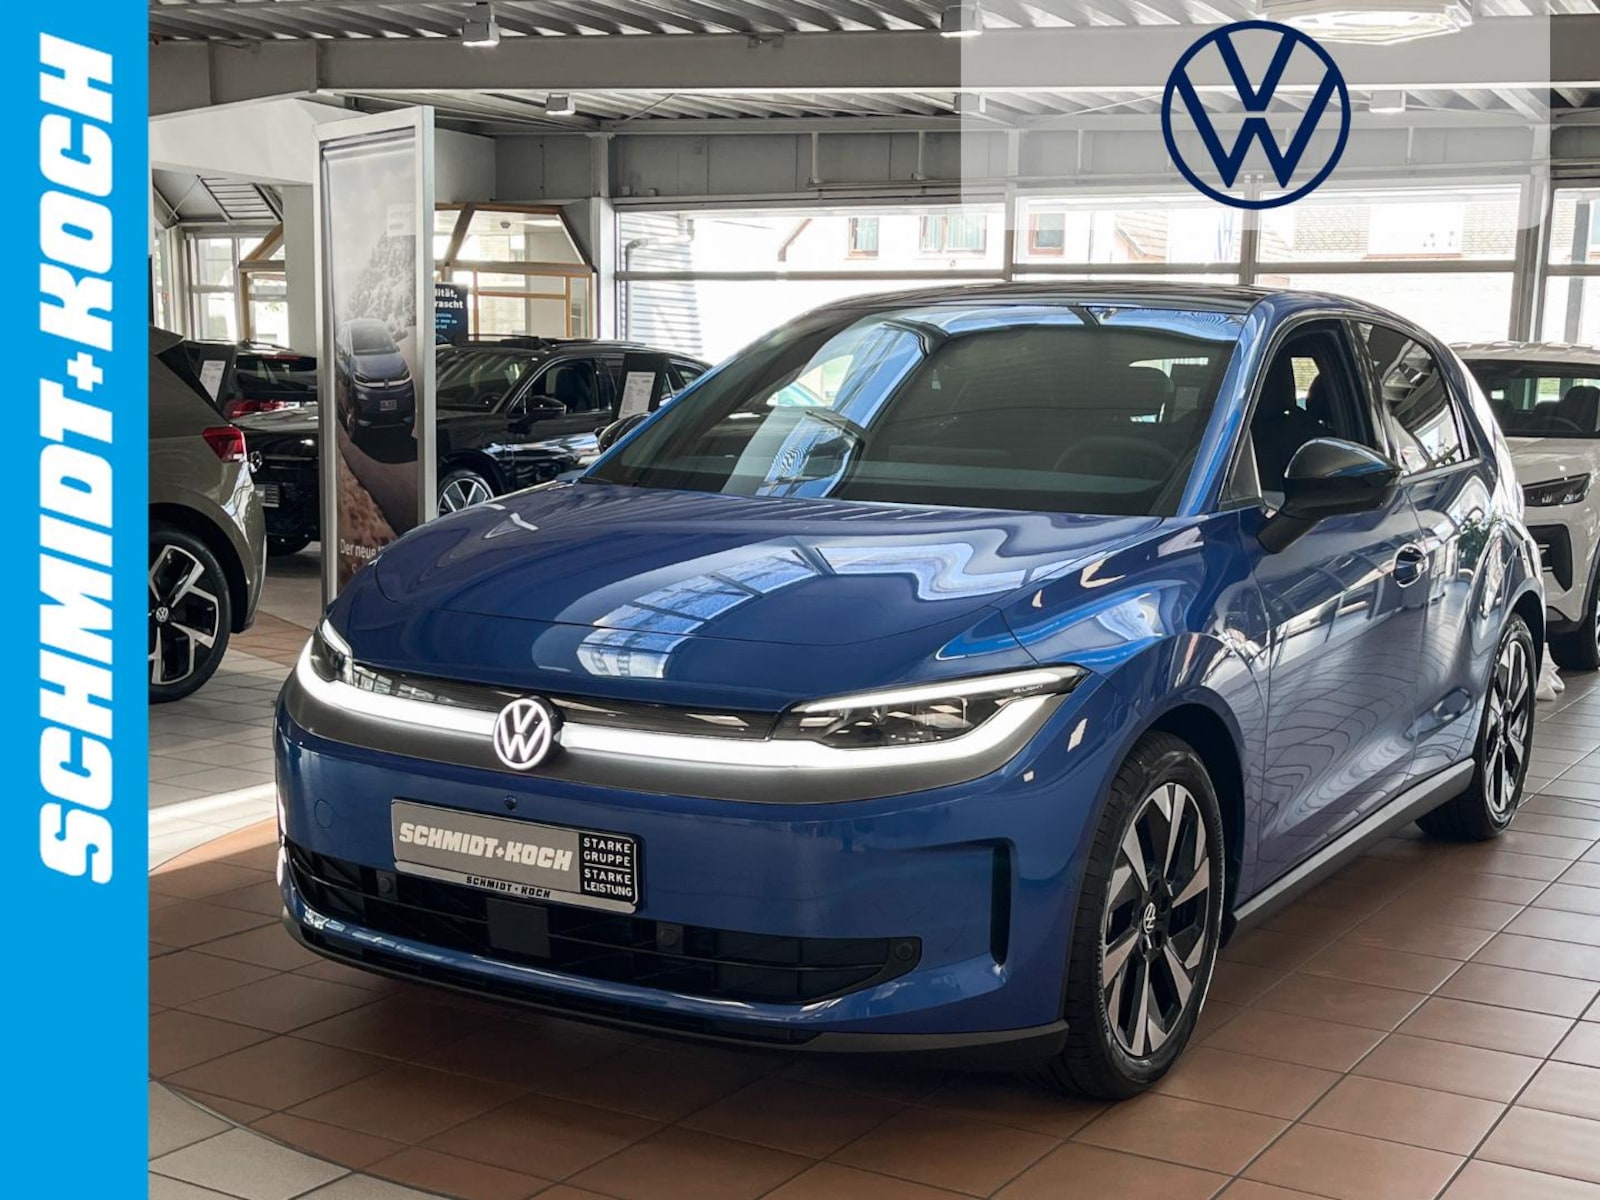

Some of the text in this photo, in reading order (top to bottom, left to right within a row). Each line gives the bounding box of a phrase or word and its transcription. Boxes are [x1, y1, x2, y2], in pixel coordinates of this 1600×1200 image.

[340, 538, 354, 556] Der
[355, 545, 377, 559] neue
[583, 837, 631, 854] STARKE
[583, 851, 631, 867] GRUPPE
[584, 868, 631, 885] STARKE
[466, 876, 512, 892] SCHMIDT
[520, 886, 551, 898] KOCH
[584, 881, 633, 897] LEISTUNG
